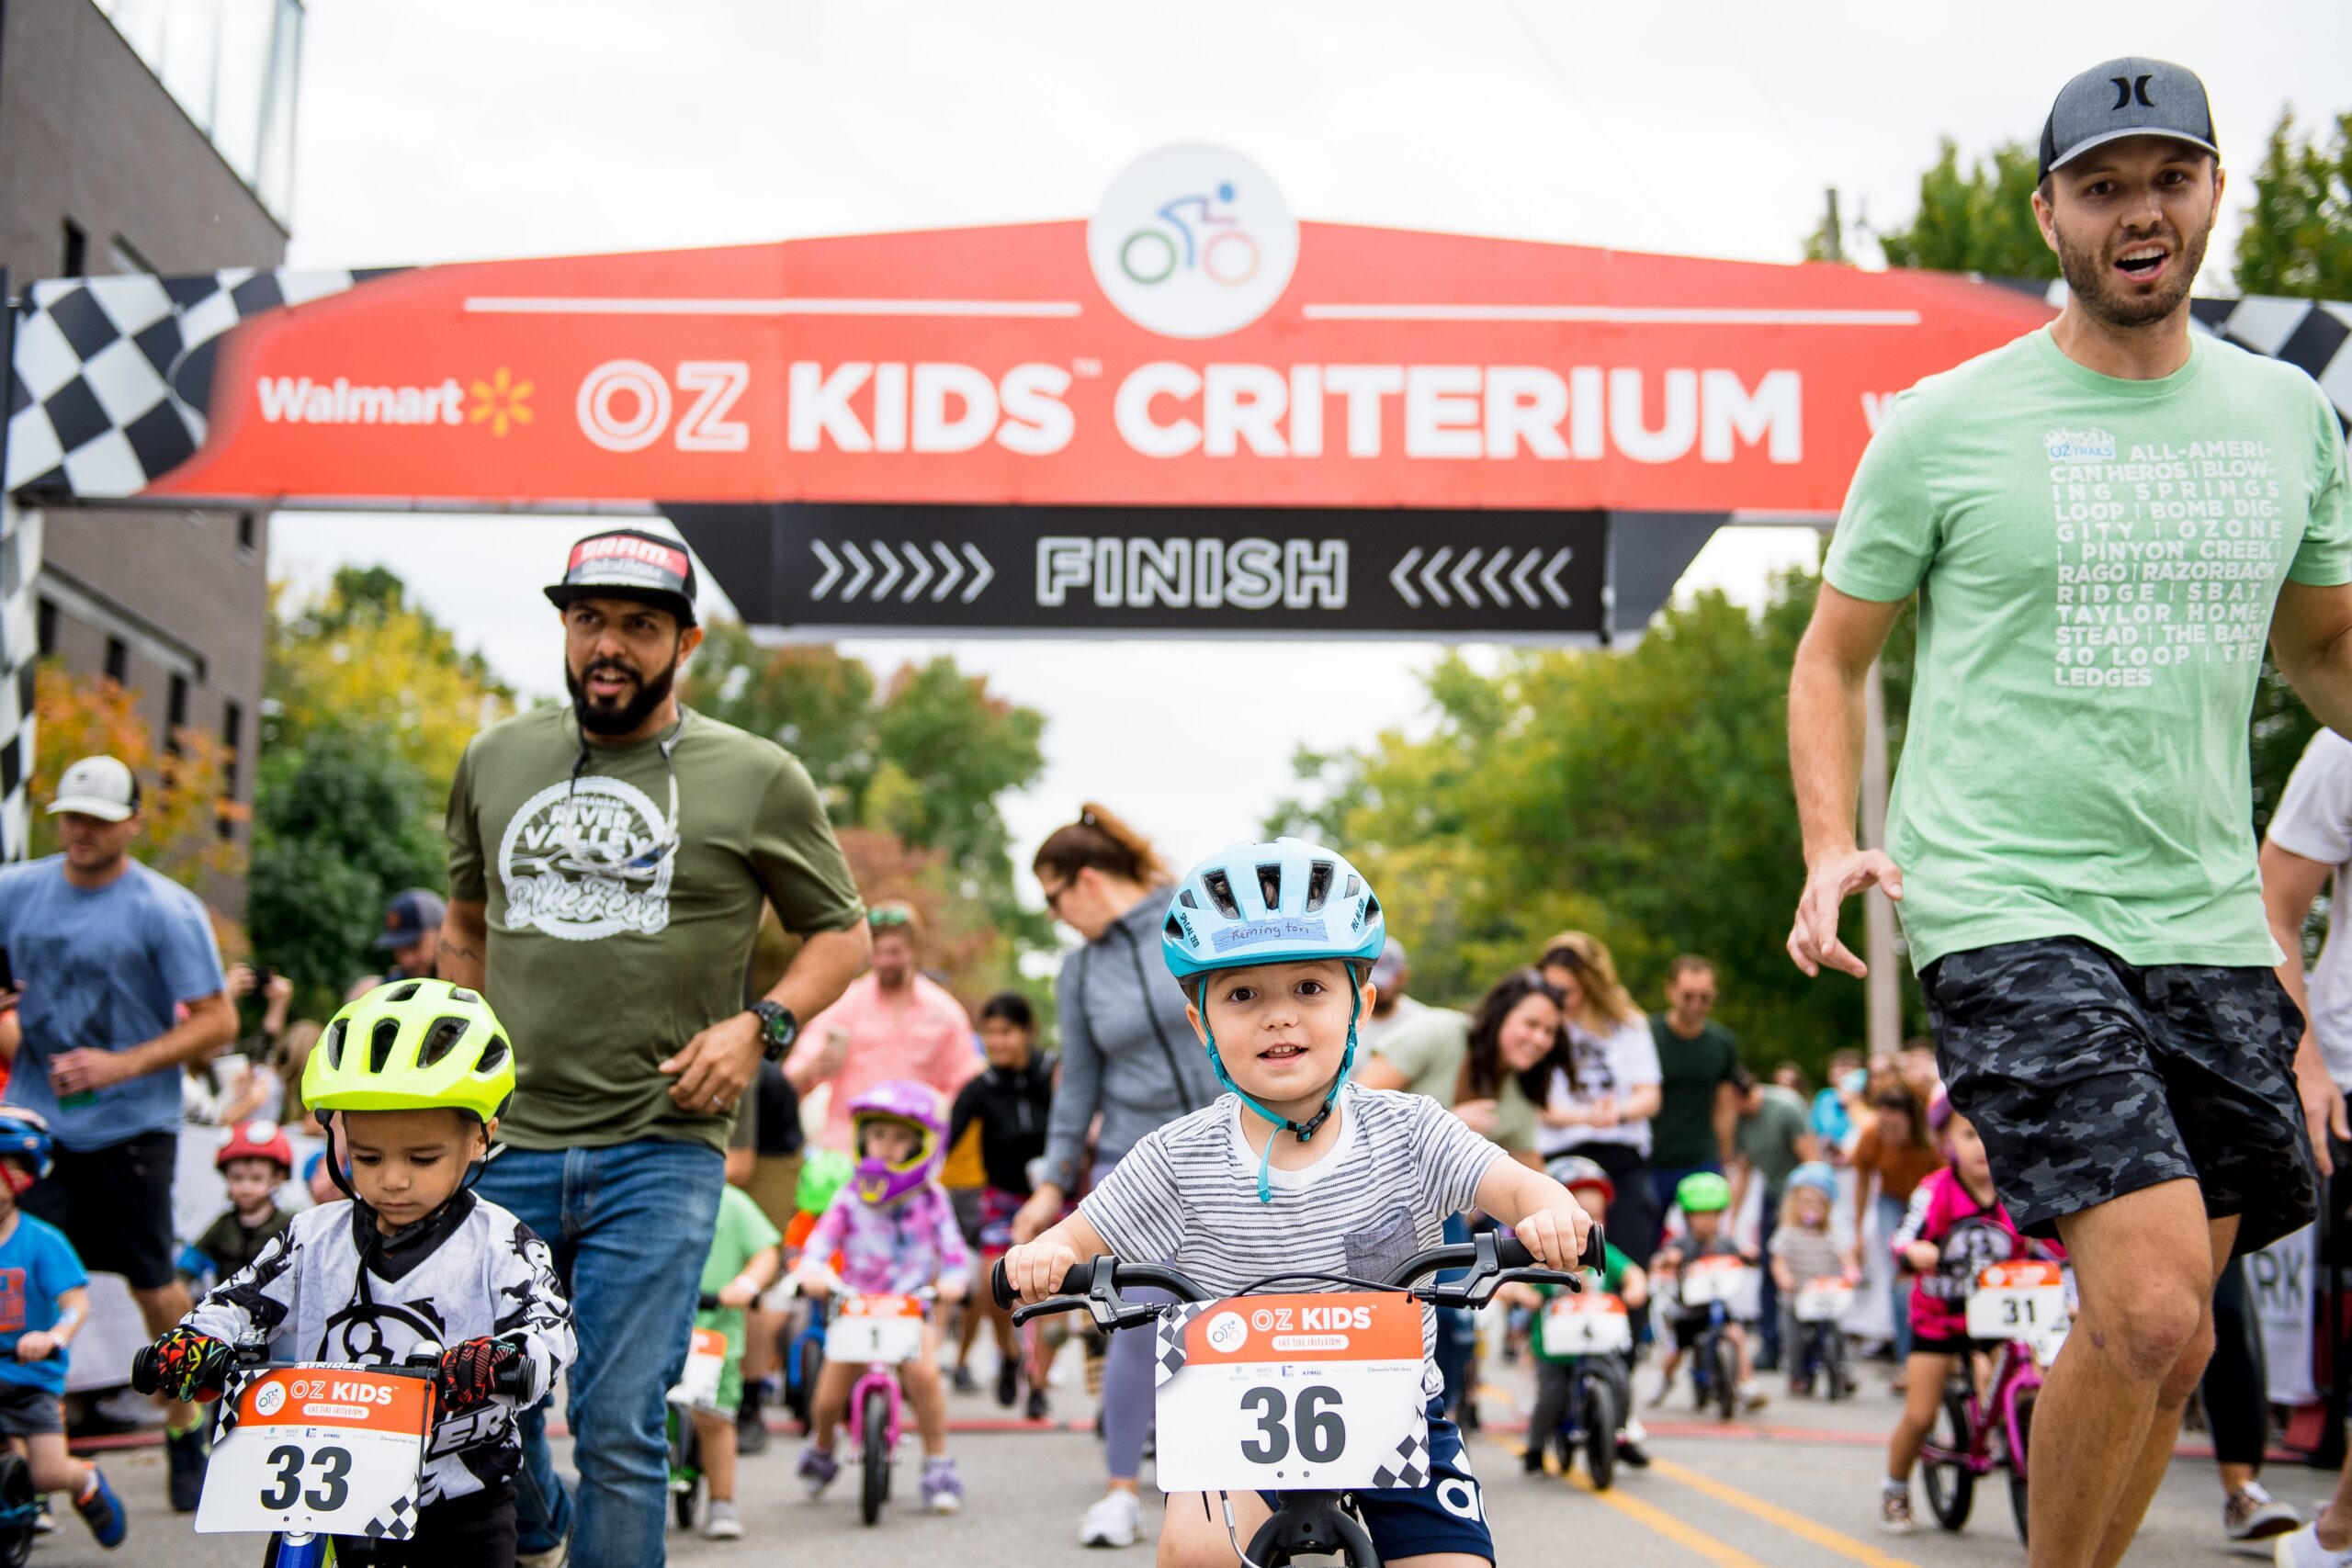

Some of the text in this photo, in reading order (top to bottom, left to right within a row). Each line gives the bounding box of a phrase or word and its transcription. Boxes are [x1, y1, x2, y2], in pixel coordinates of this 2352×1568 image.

[257, 376, 464, 424] Walmart
[576, 359, 748, 452] OZ
[1114, 361, 1803, 464] CRITERIUM
[2050, 442, 2071, 457] OZ
[2130, 441, 2273, 462] ALL-AMERI-
[2050, 459, 2276, 483] CAN HEROS BLOW-
[2052, 479, 2279, 502] ING SPRINGS
[2054, 502, 2124, 522] LOOP
[2151, 499, 2224, 520] BOMB
[2057, 519, 2282, 542] GITY OZONE
[2082, 539, 2272, 561] PINYON CREEK
[1036, 536, 1349, 607] FINISH
[2058, 560, 2278, 584] RAGO RAZORBACK
[2058, 581, 2261, 603] RIDGE SBAT
[2056, 604, 2170, 625] TAYLOR
[2055, 623, 2264, 646] STEAD THE BACK
[2056, 646, 2095, 666] 40
[2113, 646, 2189, 666] LOOP
[2055, 667, 2153, 686] LEDGES
[548, 805, 632, 831] RIVER
[525, 823, 650, 855] VALLEY
[1251, 1308, 1294, 1332] OZ
[2002, 1297, 2036, 1324] 31
[294, 1361, 368, 1371] STRIDER
[290, 1380, 326, 1399] OZ
[1240, 1385, 1346, 1464] 36
[260, 1444, 353, 1512] 33
